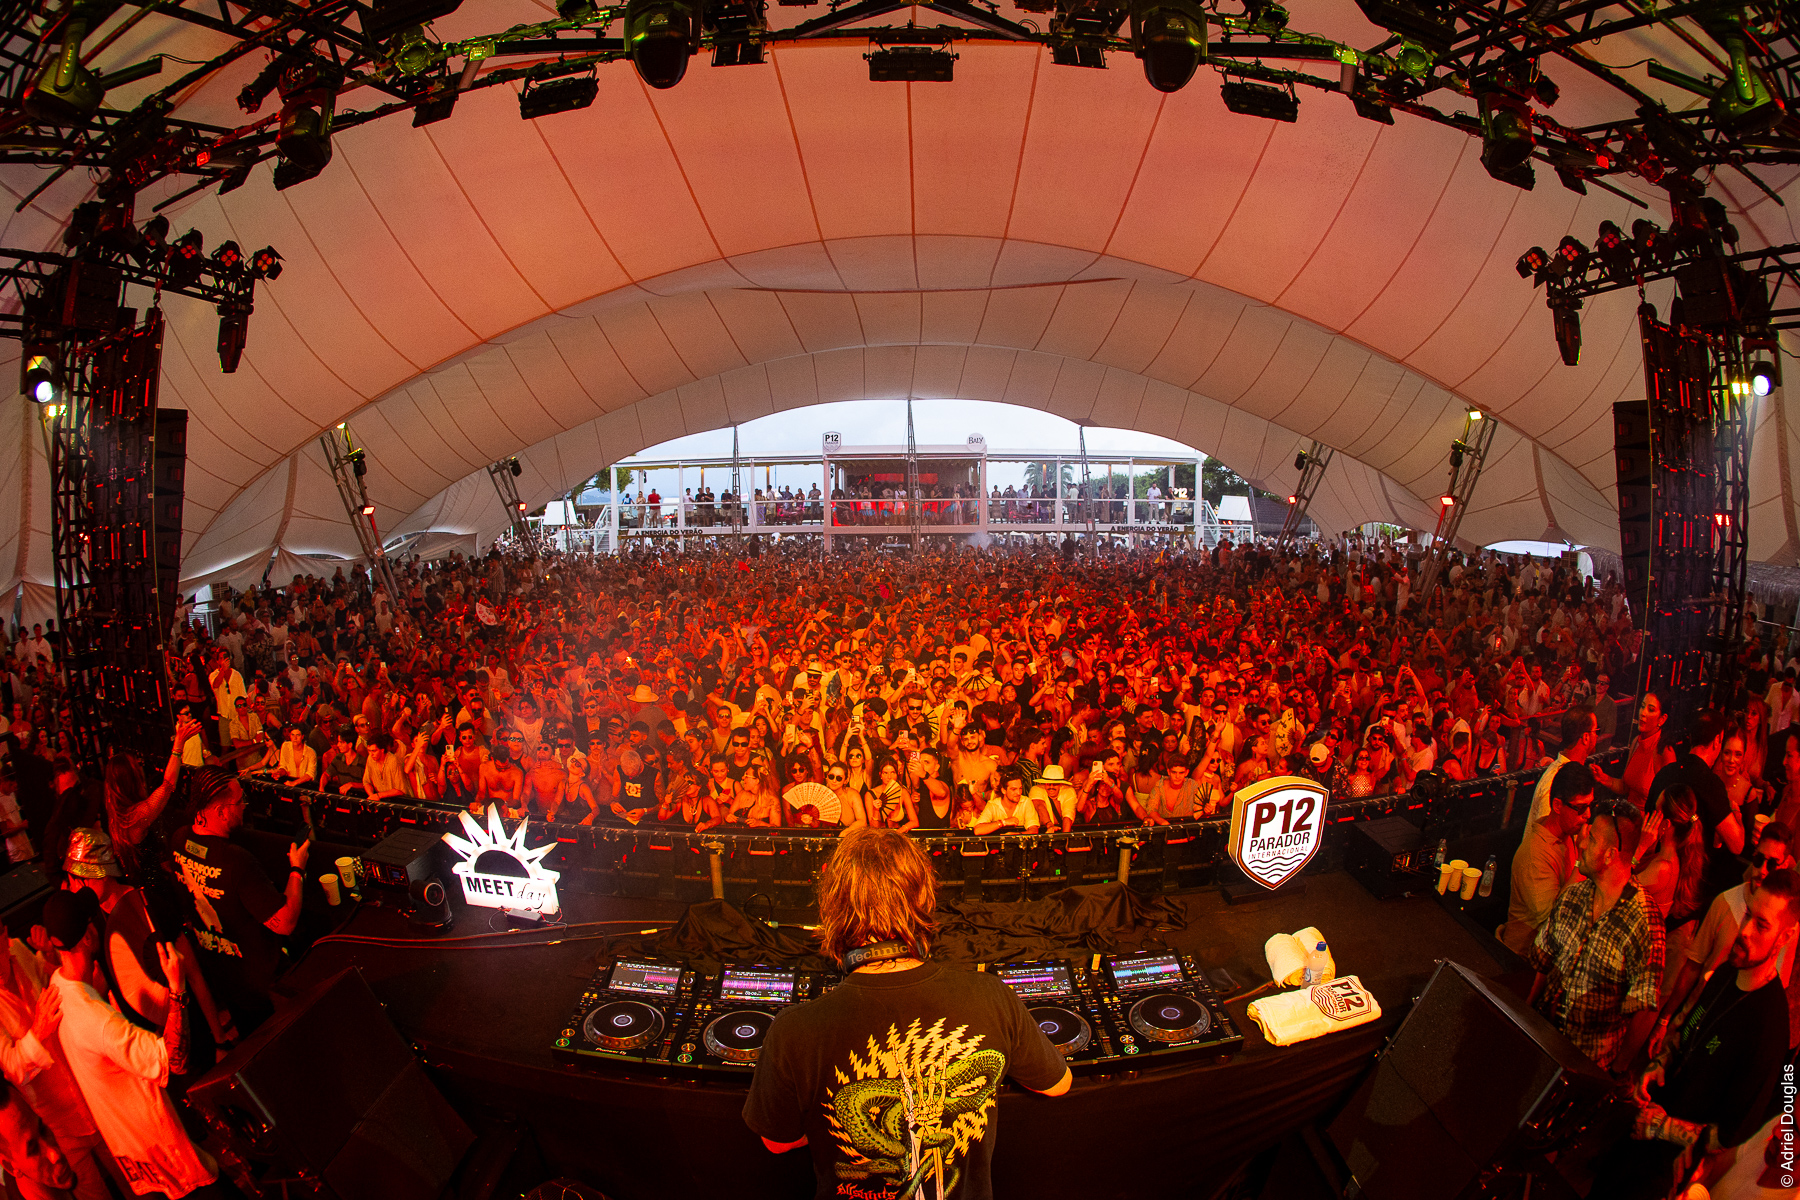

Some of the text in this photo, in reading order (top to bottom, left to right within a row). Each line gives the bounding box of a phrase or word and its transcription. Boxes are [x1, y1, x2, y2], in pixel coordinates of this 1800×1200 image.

[825, 434, 839, 442] P12
[968, 436, 984, 445] BALY
[680, 527, 704, 535] VERÃO
[1251, 796, 1316, 839] P12
[1248, 845, 1308, 860] INTERNACIONAL
[1249, 831, 1311, 853] PARADOR
[466, 876, 546, 910] MEET day
[848, 943, 908, 965] Technic
[1330, 980, 1365, 1012] P12
